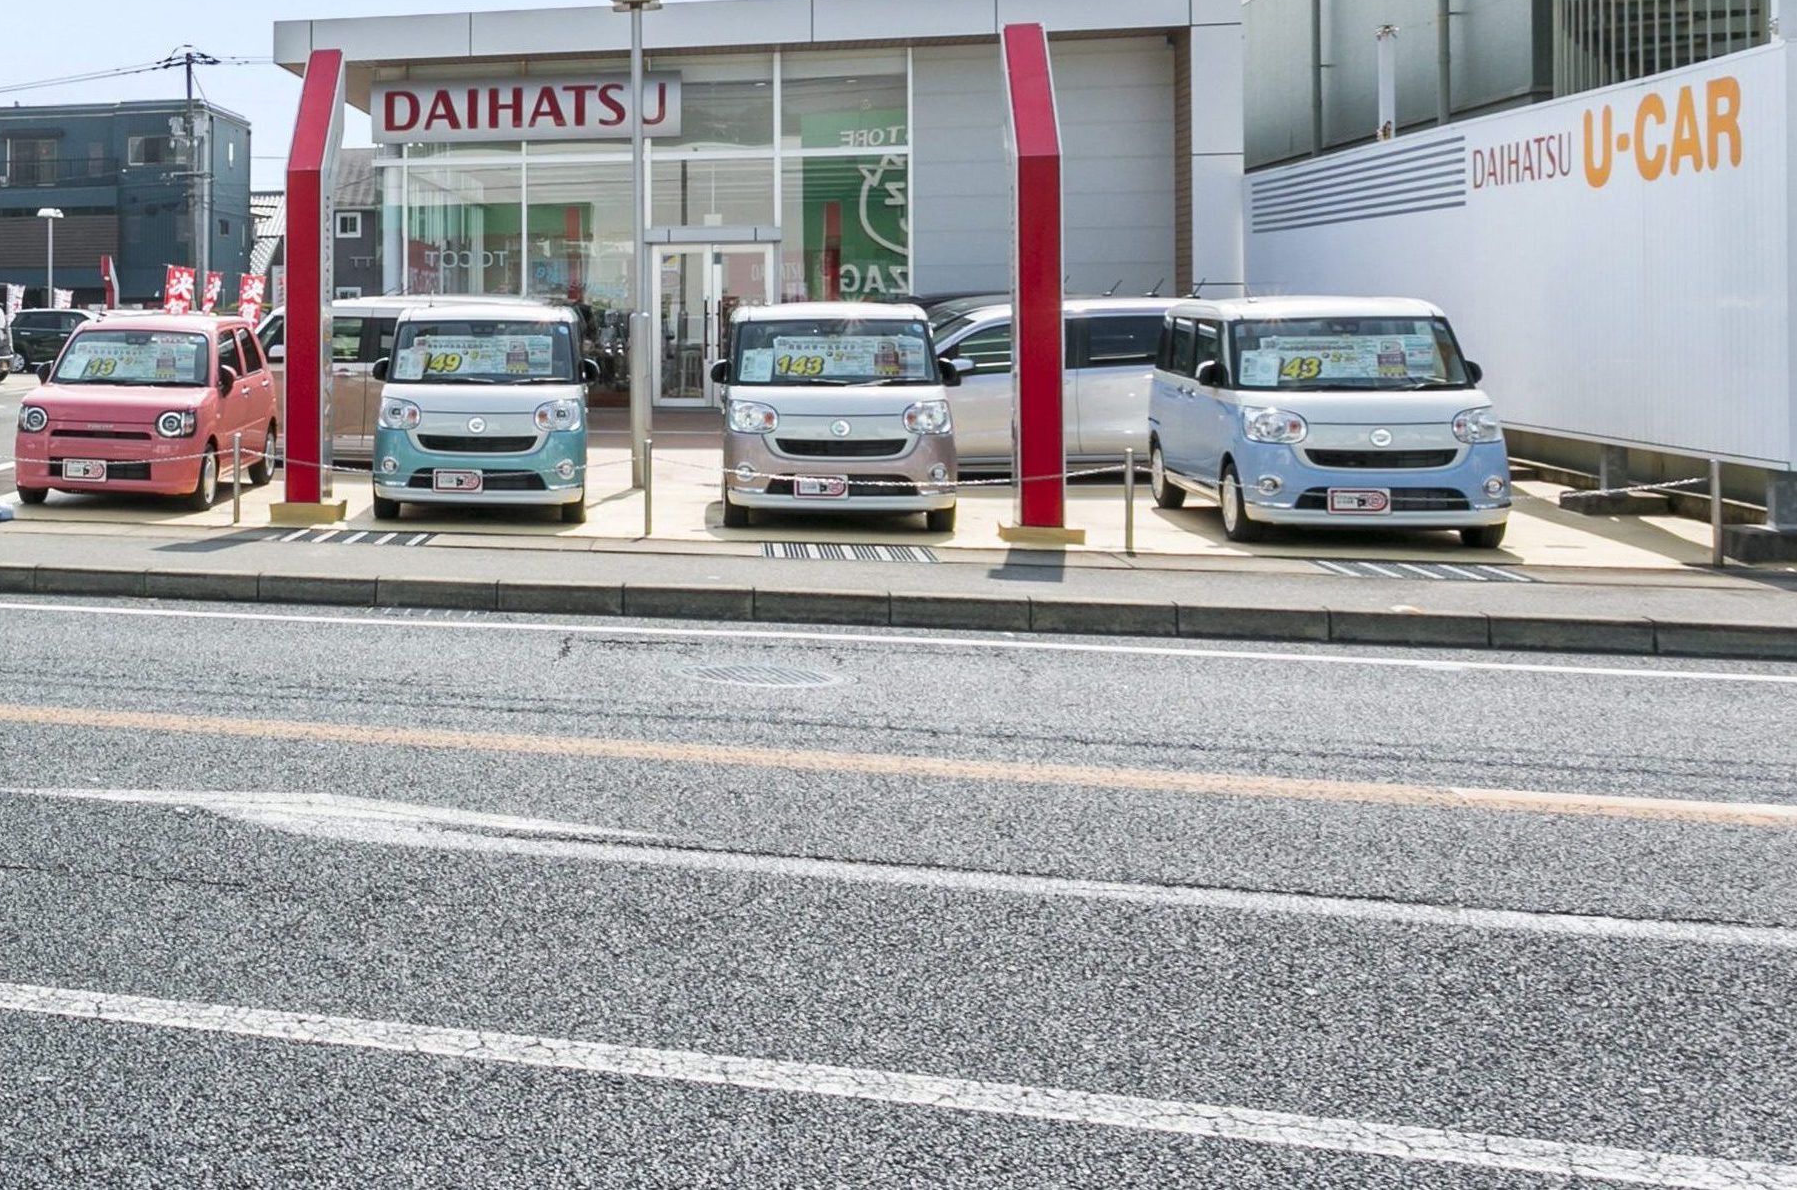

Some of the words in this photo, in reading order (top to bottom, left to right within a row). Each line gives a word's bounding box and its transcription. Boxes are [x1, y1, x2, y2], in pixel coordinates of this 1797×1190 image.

[384, 83, 666, 132] DAIHATSU
[1473, 131, 1571, 189] DAIHATSU
[1583, 75, 1742, 188] U-CAR
[776, 354, 824, 376] 143
